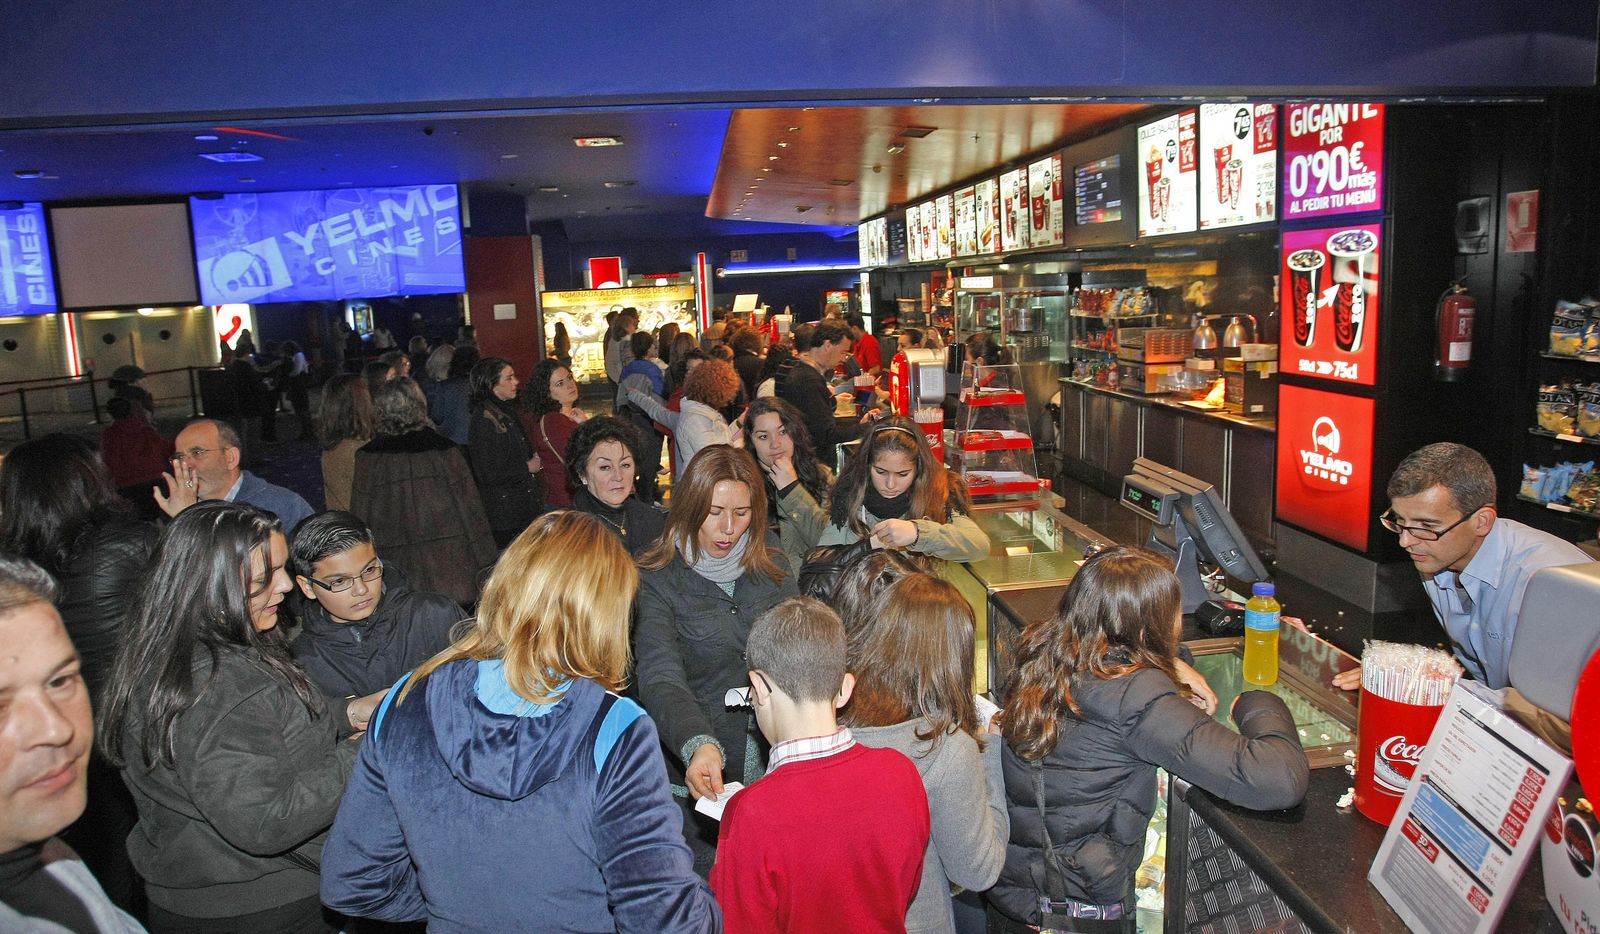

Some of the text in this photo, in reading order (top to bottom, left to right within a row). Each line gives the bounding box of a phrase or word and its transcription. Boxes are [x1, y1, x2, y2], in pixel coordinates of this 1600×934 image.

[1319, 126, 1343, 146] POR
[1290, 184, 1377, 214] AL PEDIR TU MENÚ
[283, 184, 459, 256] YELMO
[16, 213, 48, 305] CINES
[315, 216, 458, 276] CINES
[606, 289, 621, 297] LOS
[622, 287, 651, 296] GLOBOS
[1300, 450, 1353, 476] YELMO
[1304, 466, 1348, 485] CINES
